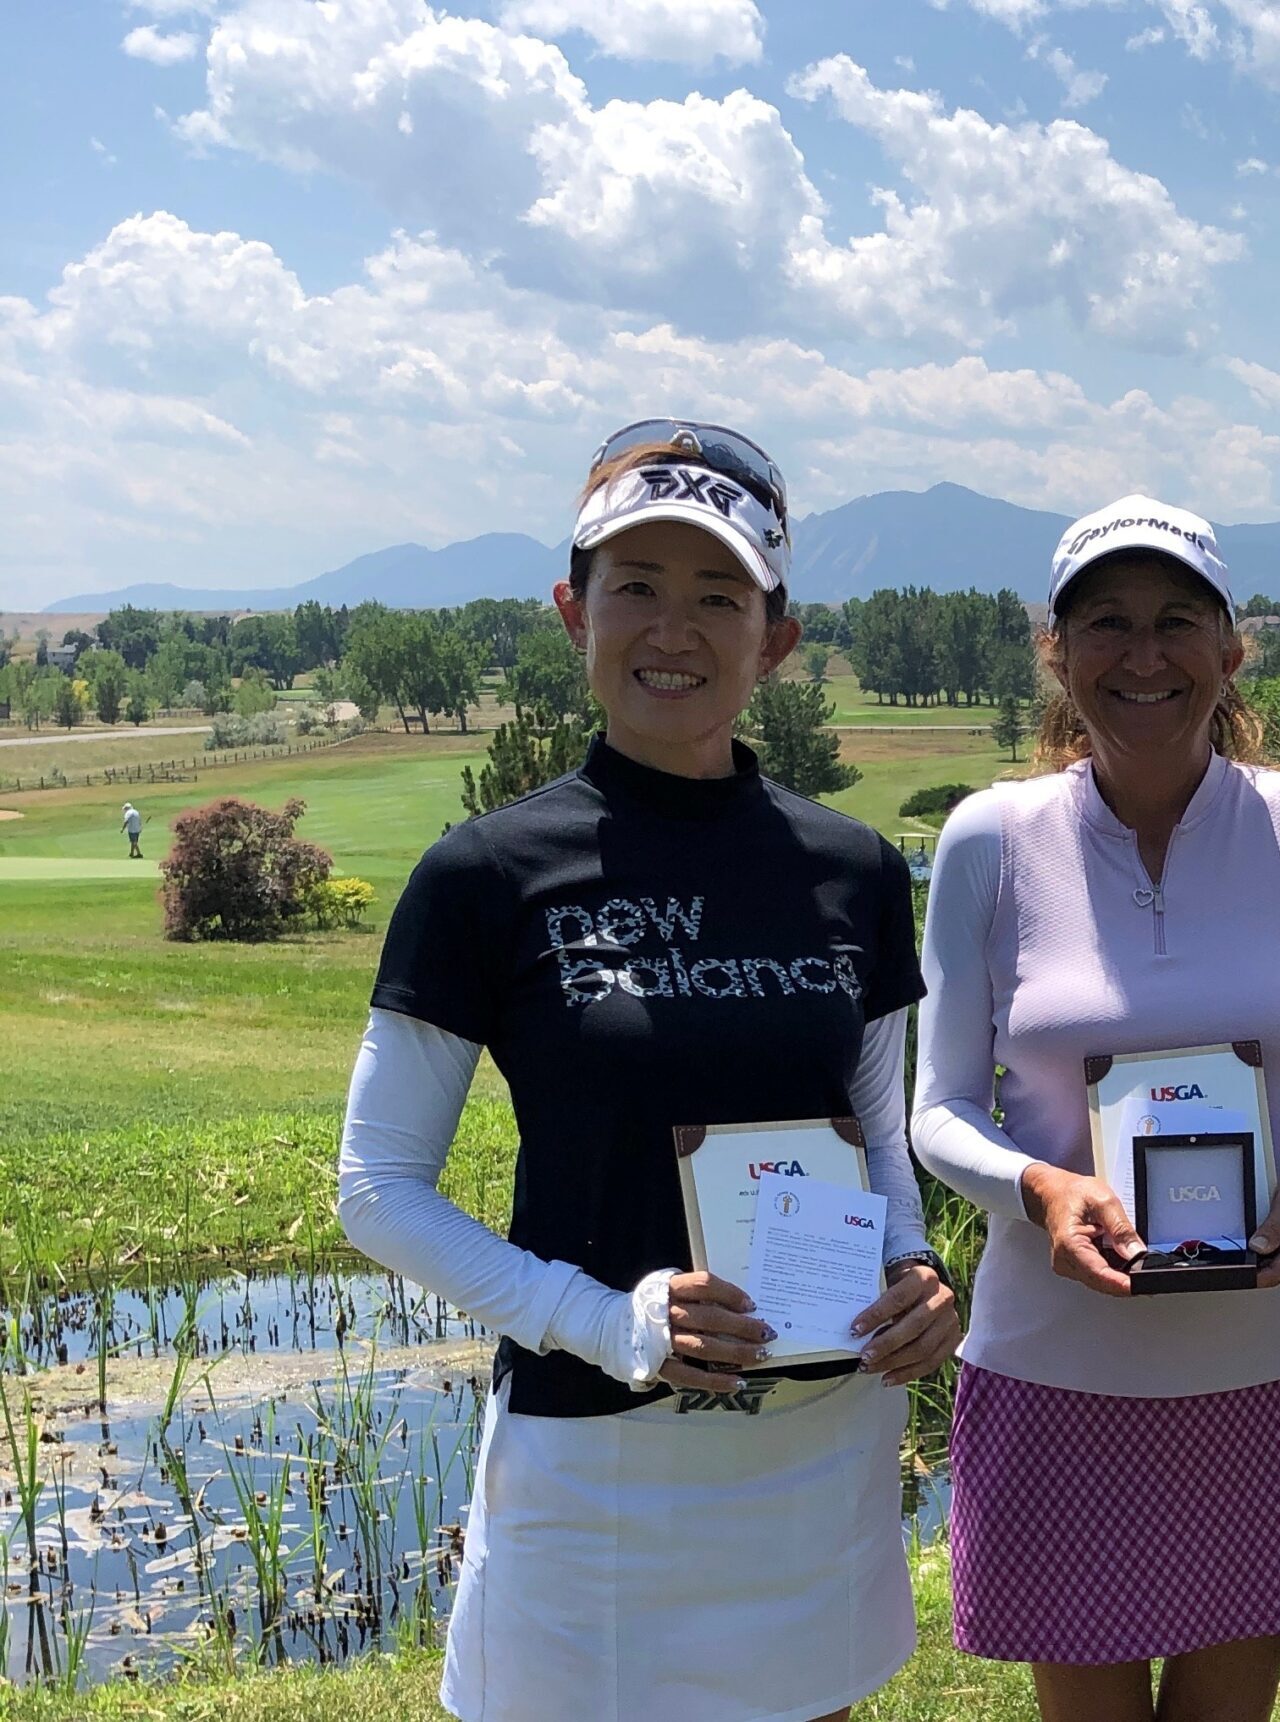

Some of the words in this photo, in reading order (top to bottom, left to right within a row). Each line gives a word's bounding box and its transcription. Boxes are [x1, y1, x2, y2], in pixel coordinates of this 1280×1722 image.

[640, 469, 742, 517] PXG
[545, 896, 705, 948] new
[1151, 1083, 1204, 1102] USGA
[1169, 1185, 1222, 1202] USGA
[844, 1214, 875, 1230] USGA
